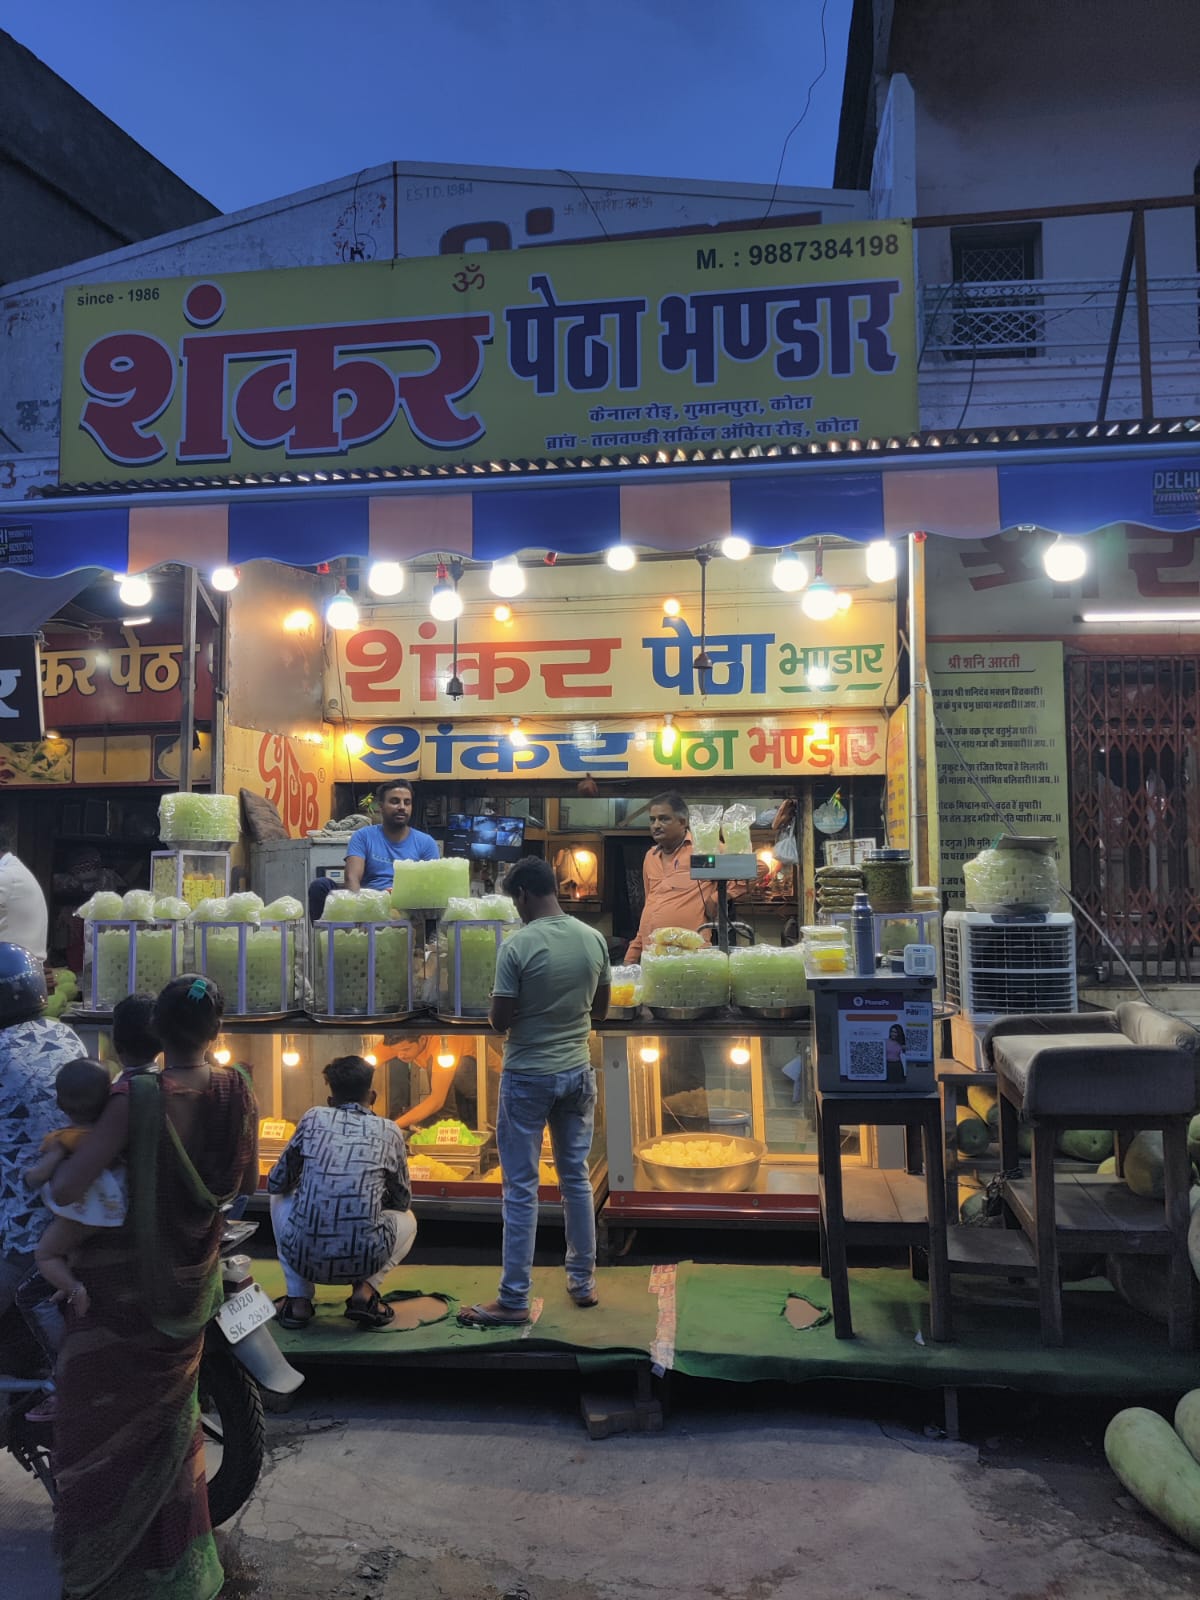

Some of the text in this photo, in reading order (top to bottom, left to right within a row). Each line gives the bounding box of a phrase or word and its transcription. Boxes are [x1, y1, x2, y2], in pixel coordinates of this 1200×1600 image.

[749, 233, 900, 266] 9887384198
[77, 293, 114, 306] since
[128, 288, 160, 302] 1986
[80, 274, 900, 464] शंकर पेठा भण्डार
[683, 399, 765, 420] गुमानपुरा,
[769, 394, 813, 411] कोटा
[816, 417, 860, 433] कोटा
[345, 621, 622, 702] शंकर
[642, 616, 776, 695] पेठा
[948, 653, 1020, 669] श्री शनि आरती
[41, 650, 102, 697] कर
[359, 723, 635, 774] शंकर
[227, 1293, 254, 1316] RJ20
[229, 1322, 247, 1340] SK
